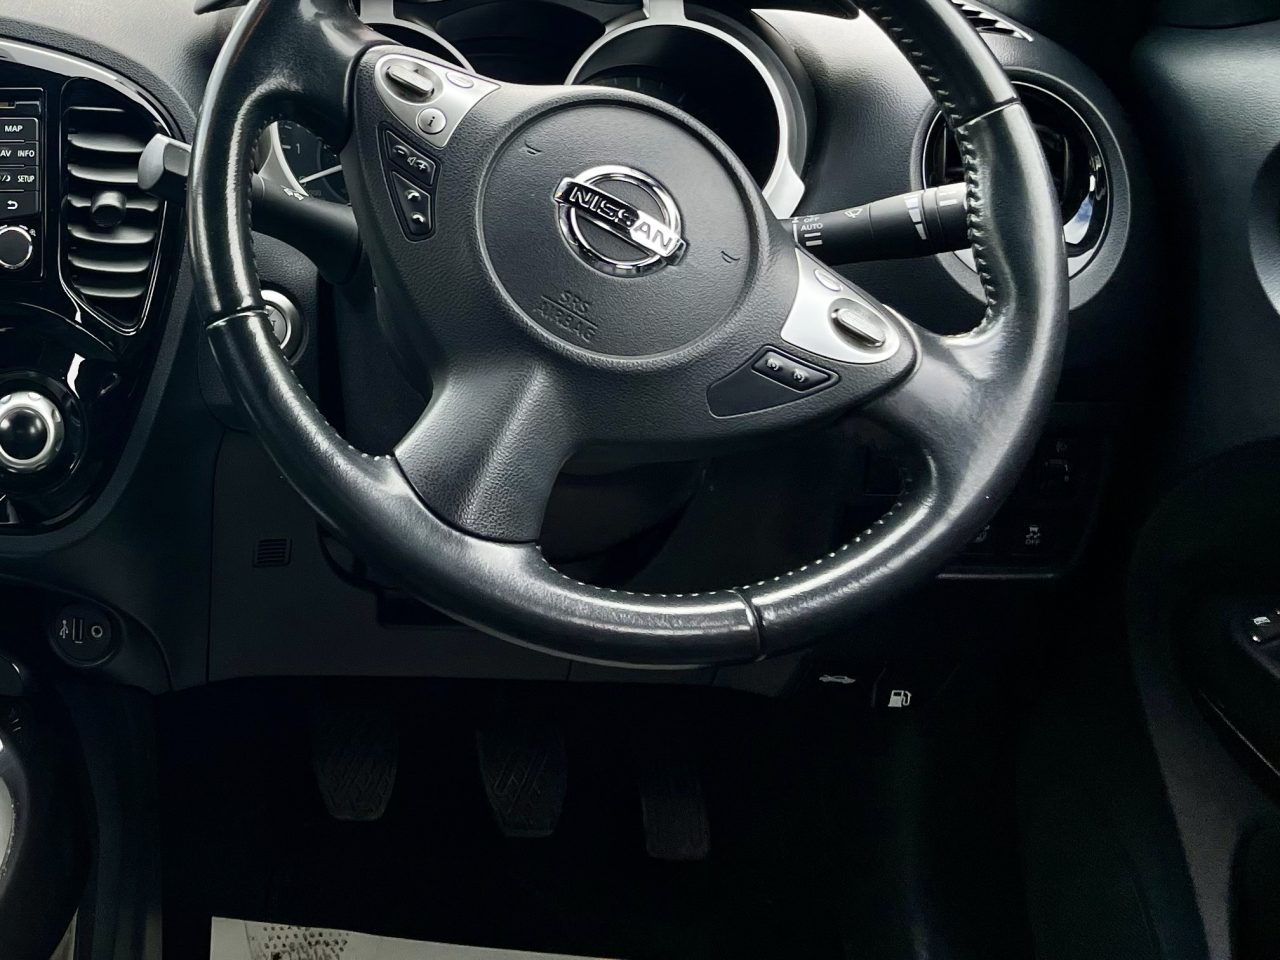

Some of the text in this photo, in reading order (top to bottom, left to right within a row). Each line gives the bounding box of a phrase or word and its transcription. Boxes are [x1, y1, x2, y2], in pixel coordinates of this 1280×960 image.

[17, 149, 35, 157] INFO
[17, 175, 35, 183] SETUP
[568, 186, 673, 252] NISSAN
[800, 222, 824, 232] AUTO
[558, 289, 592, 316] SRS
[532, 301, 597, 344] AIRBAG
